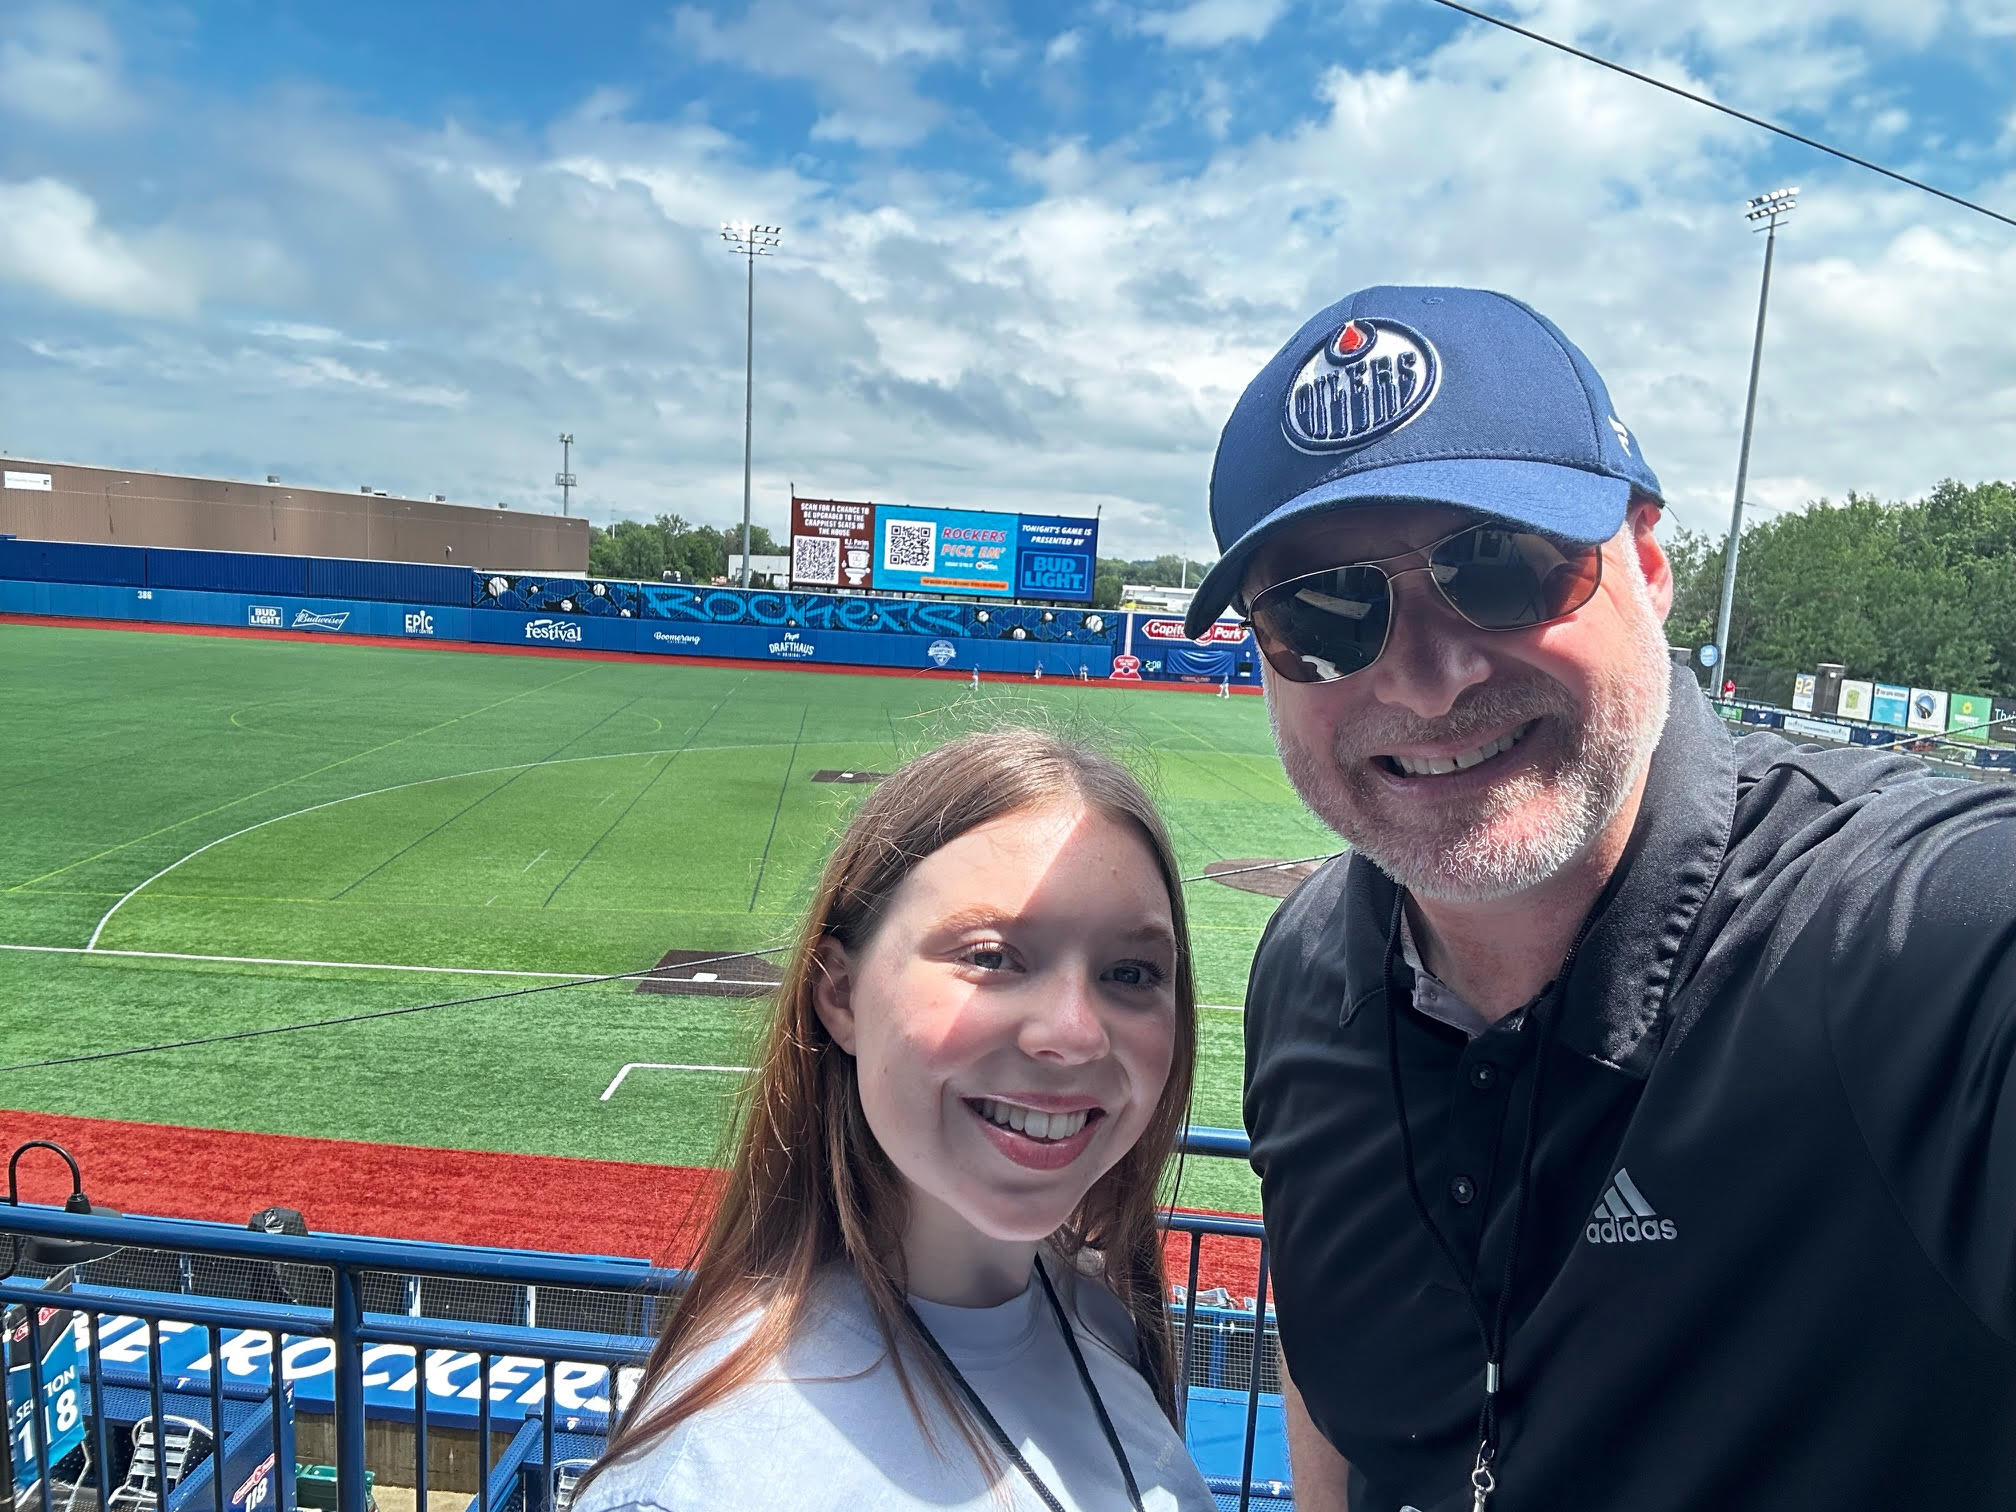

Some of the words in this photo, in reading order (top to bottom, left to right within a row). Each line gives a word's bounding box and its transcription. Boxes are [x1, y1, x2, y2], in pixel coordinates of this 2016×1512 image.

[1295, 352, 1417, 440] OILERS
[801, 503, 818, 511] SCAN
[819, 504, 830, 512] FOR
[836, 505, 860, 514] CHANCE
[861, 507, 870, 515] TO
[813, 512, 843, 520] UPGRADED
[853, 514, 865, 522] THE
[805, 519, 837, 528] CRAPPIEST
[837, 521, 856, 530] SEATS
[1022, 525, 1061, 534] TONIGHT'S
[1061, 527, 1083, 535] GAME
[1084, 528, 1093, 536] IS
[831, 529, 850, 537] HOUSE
[941, 527, 1007, 542] ROCKERS
[1031, 536, 1073, 545] PRESENTED
[1073, 538, 1085, 546] BY
[941, 544, 976, 558] PICK
[1033, 556, 1076, 573] BUD
[1024, 571, 1084, 589] LIGHT
[255, 608, 277, 616] BUD
[295, 612, 344, 624] Budweiser
[251, 615, 280, 625] LIGHT
[405, 610, 434, 630] EPIC
[525, 619, 582, 642] festival
[1215, 627, 1241, 640] Park
[653, 631, 701, 645] Boomerang
[769, 641, 815, 656] DRAFTHAUS
[1586, 1214, 1678, 1244] adidas
[245, 1477, 268, 1512] 118
